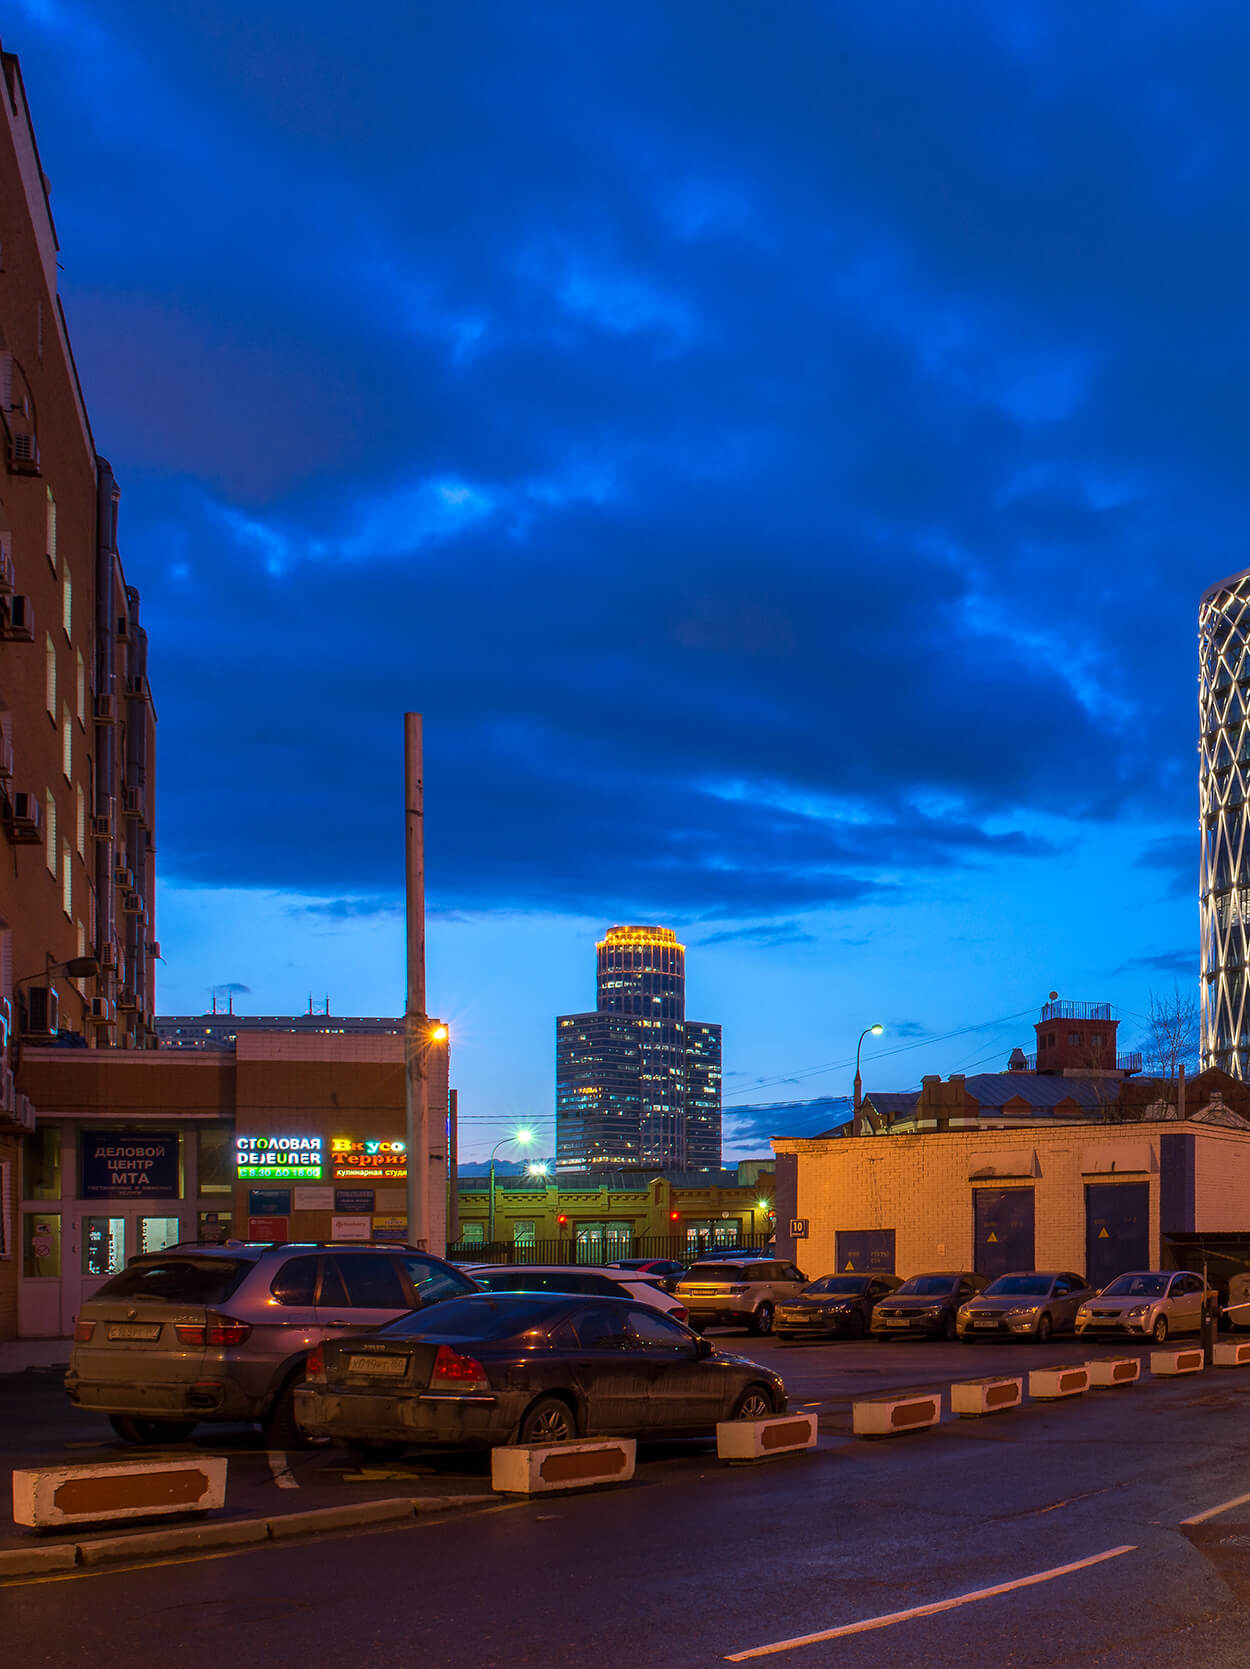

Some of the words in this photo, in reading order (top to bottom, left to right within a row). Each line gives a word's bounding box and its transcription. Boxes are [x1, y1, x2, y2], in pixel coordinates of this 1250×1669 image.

[237, 1138, 321, 1149] СТОЛОВАЯ
[94, 1145, 165, 1158] ДЕЛОВОЙ
[107, 1160, 153, 1170] ЦЕНТР
[249, 1168, 271, 1177] 8.30
[275, 1168, 290, 1177] ДО
[336, 1169, 383, 1178] кулинарная
[111, 1172, 150, 1185] МТА
[793, 1222, 803, 1232] 10
